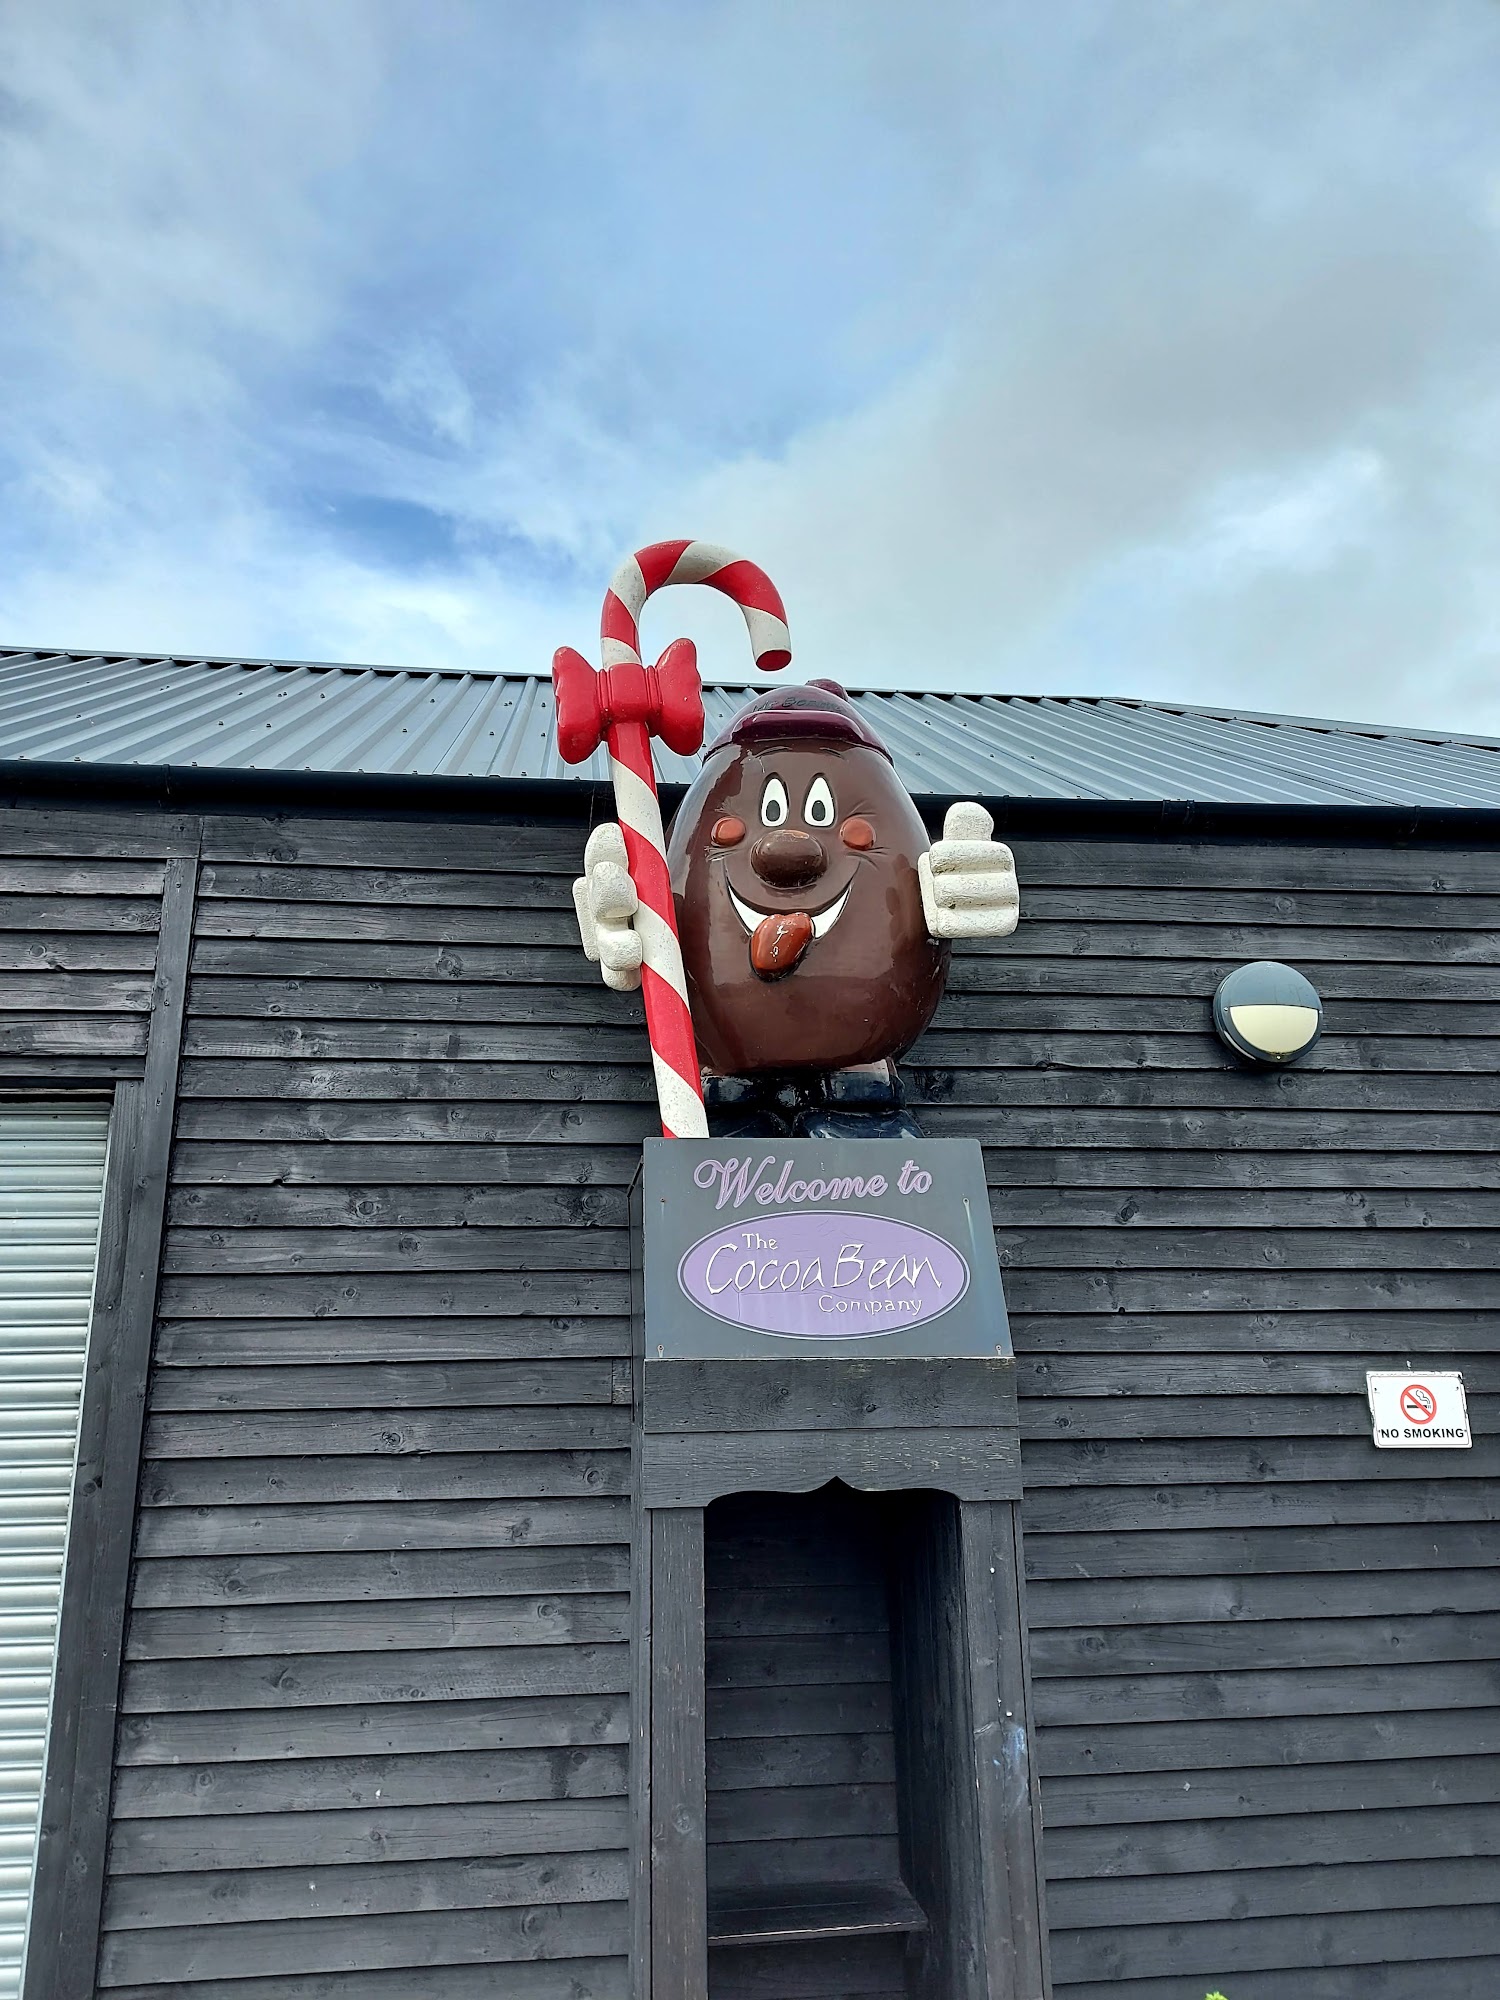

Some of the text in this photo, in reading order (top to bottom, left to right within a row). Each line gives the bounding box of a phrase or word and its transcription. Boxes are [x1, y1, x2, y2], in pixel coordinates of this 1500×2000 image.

[694, 1156, 933, 1210] Welcome to
[742, 1233, 778, 1251] The
[705, 1243, 943, 1294] Cocoa Bean
[818, 1295, 923, 1316] Company
[1381, 1428, 1464, 1438] NO SMOKING
